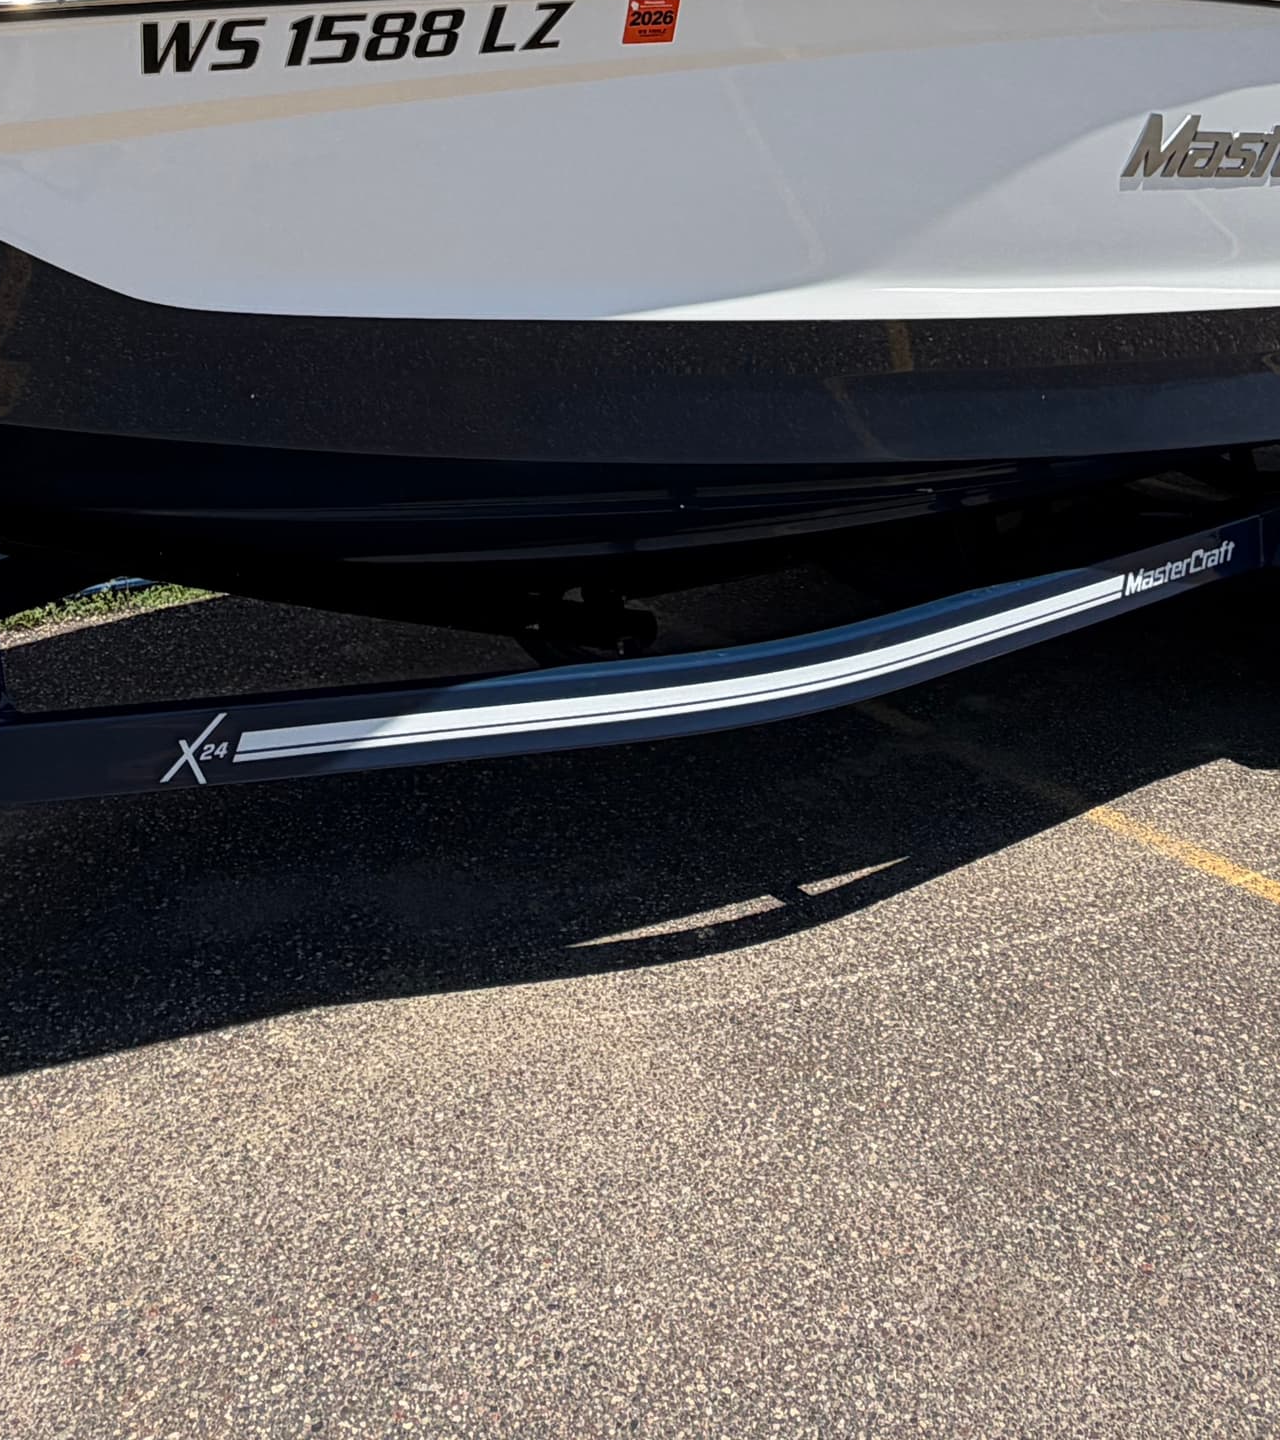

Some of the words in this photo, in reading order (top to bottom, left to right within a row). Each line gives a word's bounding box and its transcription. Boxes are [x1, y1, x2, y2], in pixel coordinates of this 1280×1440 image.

[140, 17, 268, 75] WS
[284, 7, 467, 68] 1588
[478, 0, 575, 55] LZ
[629, 10, 674, 26] 2026
[1124, 540, 1235, 596] MasterCraft
